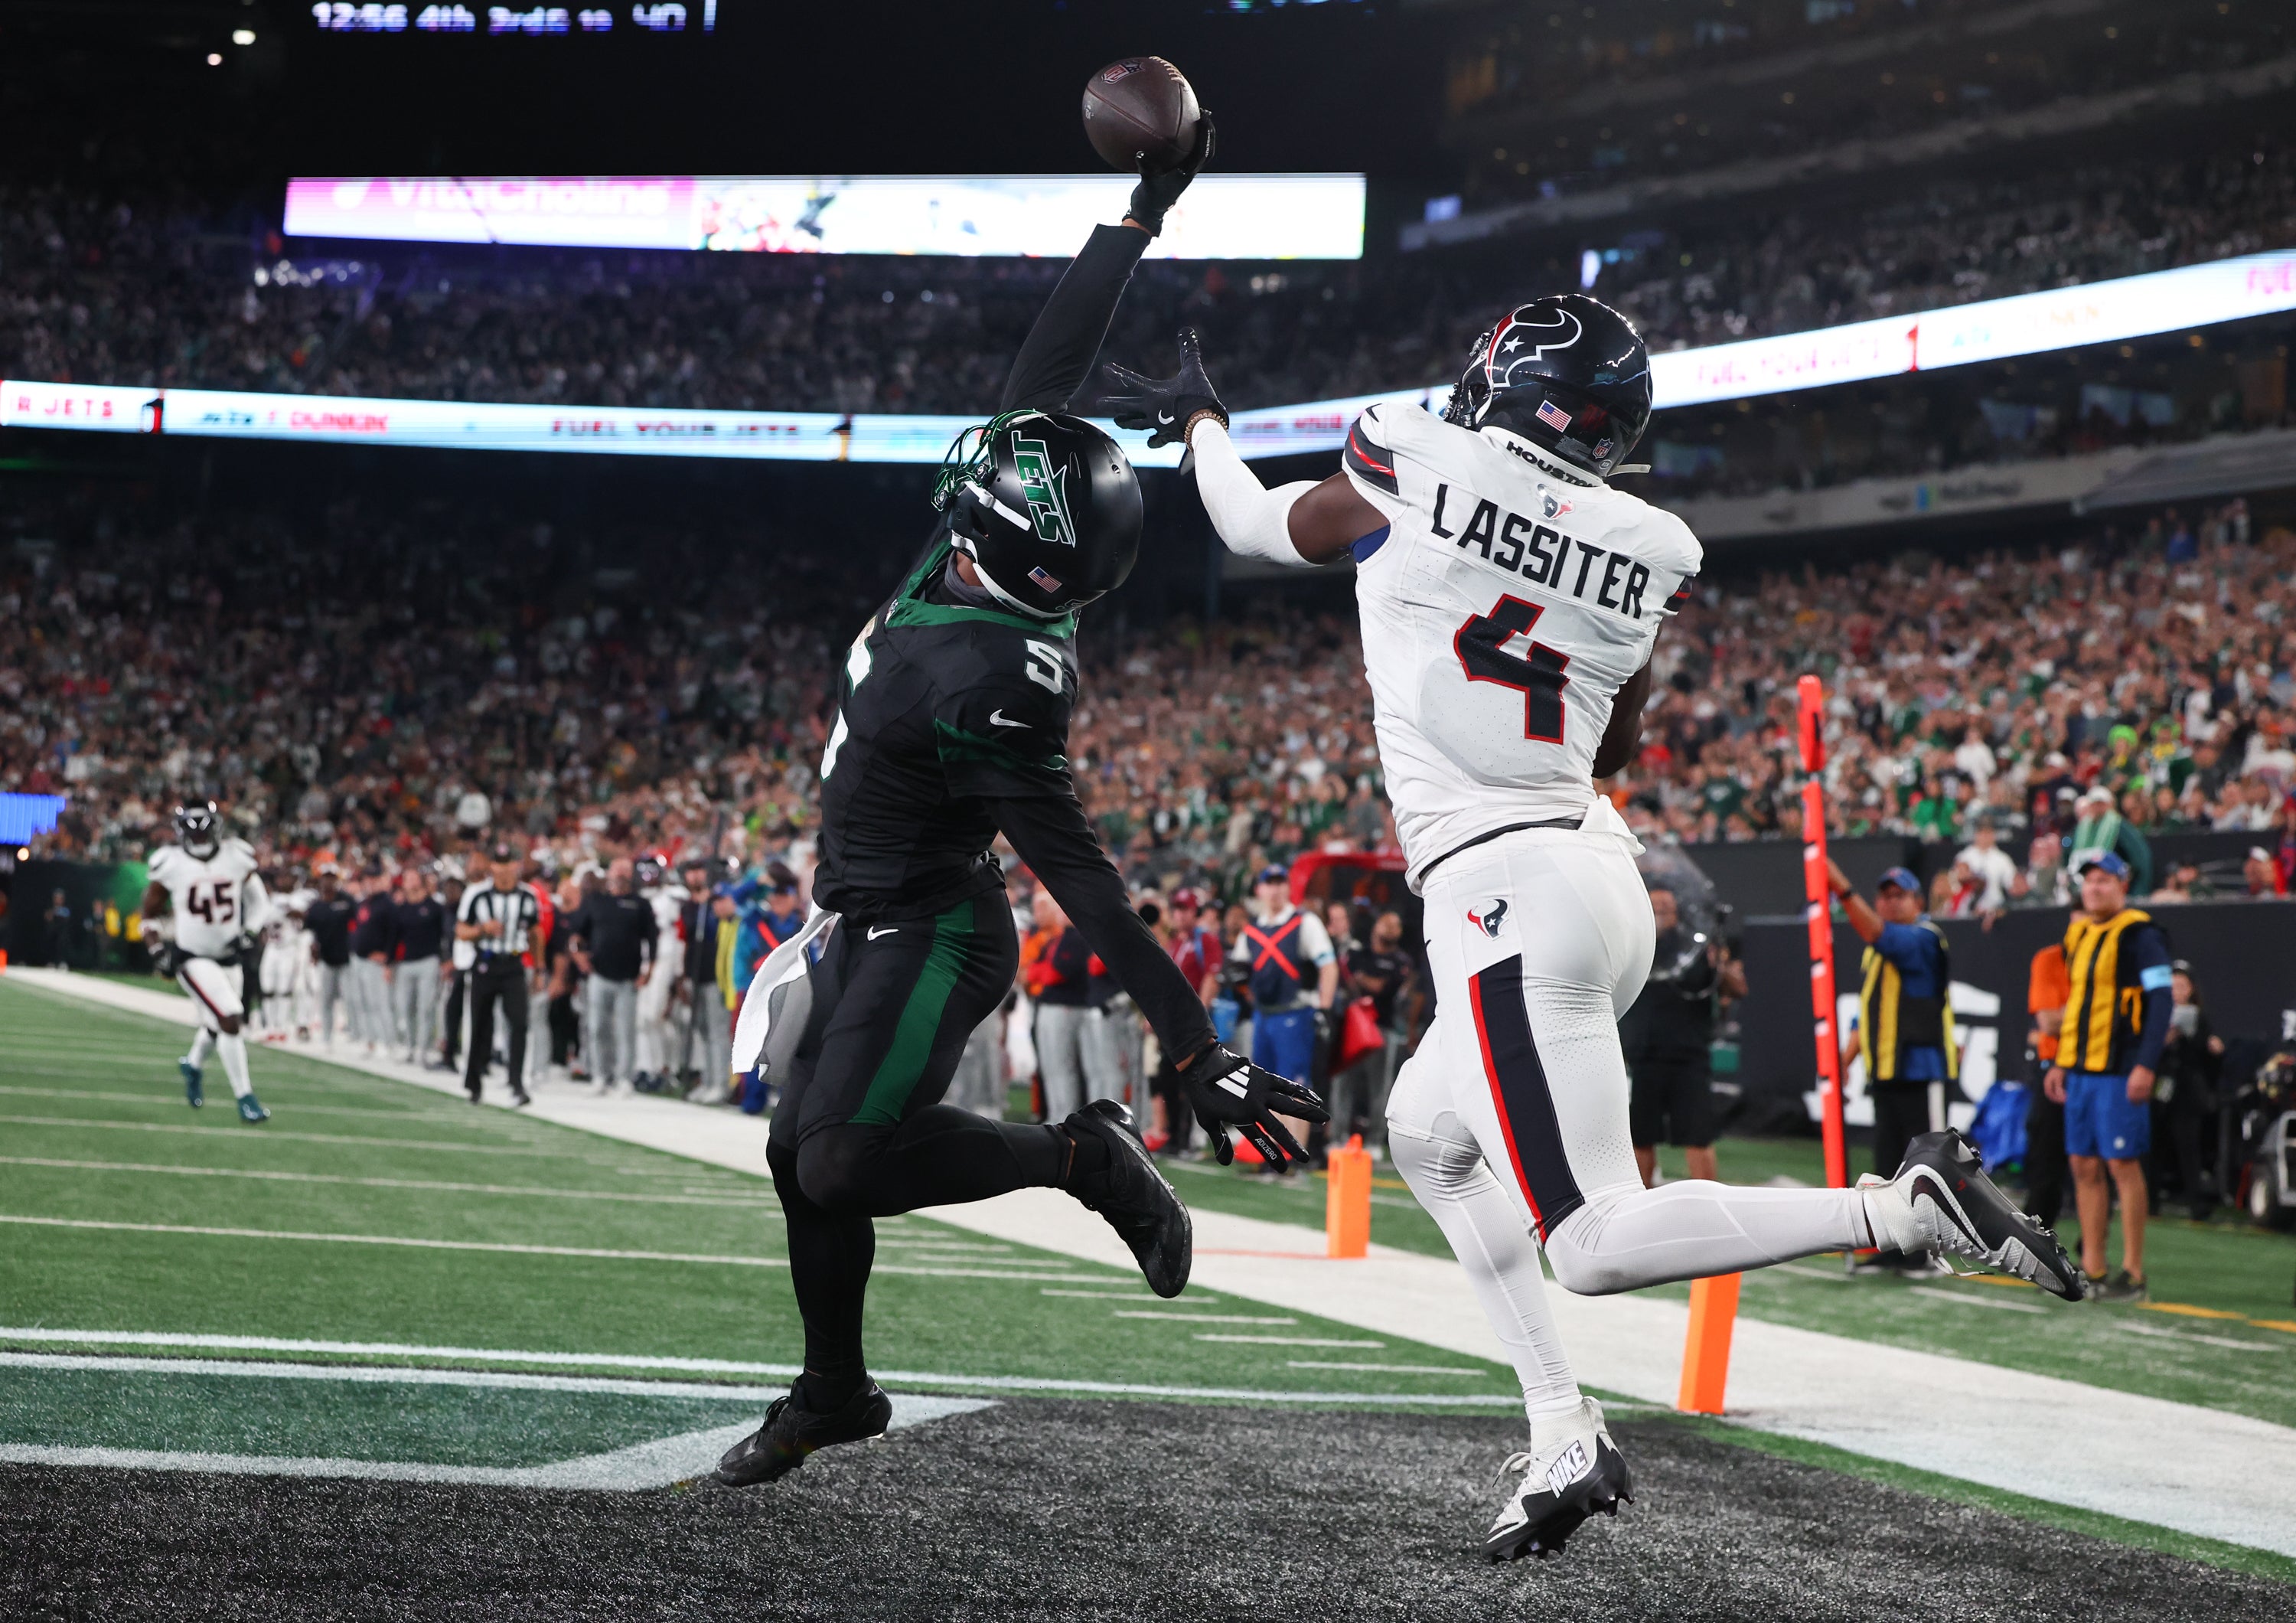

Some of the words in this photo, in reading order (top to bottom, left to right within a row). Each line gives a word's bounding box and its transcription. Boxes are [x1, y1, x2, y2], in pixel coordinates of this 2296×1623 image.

[44, 398, 113, 417] JETS
[1011, 429, 1076, 548] JETS
[1505, 440, 1599, 488] HOUSTO
[1430, 482, 1650, 619] LASSITER
[1023, 637, 1065, 695] 5
[1453, 593, 1571, 745] 4
[187, 880, 235, 925] 45
[1254, 1137, 1278, 1161] ADIZERO
[1545, 1439, 1589, 1500] NIKE
